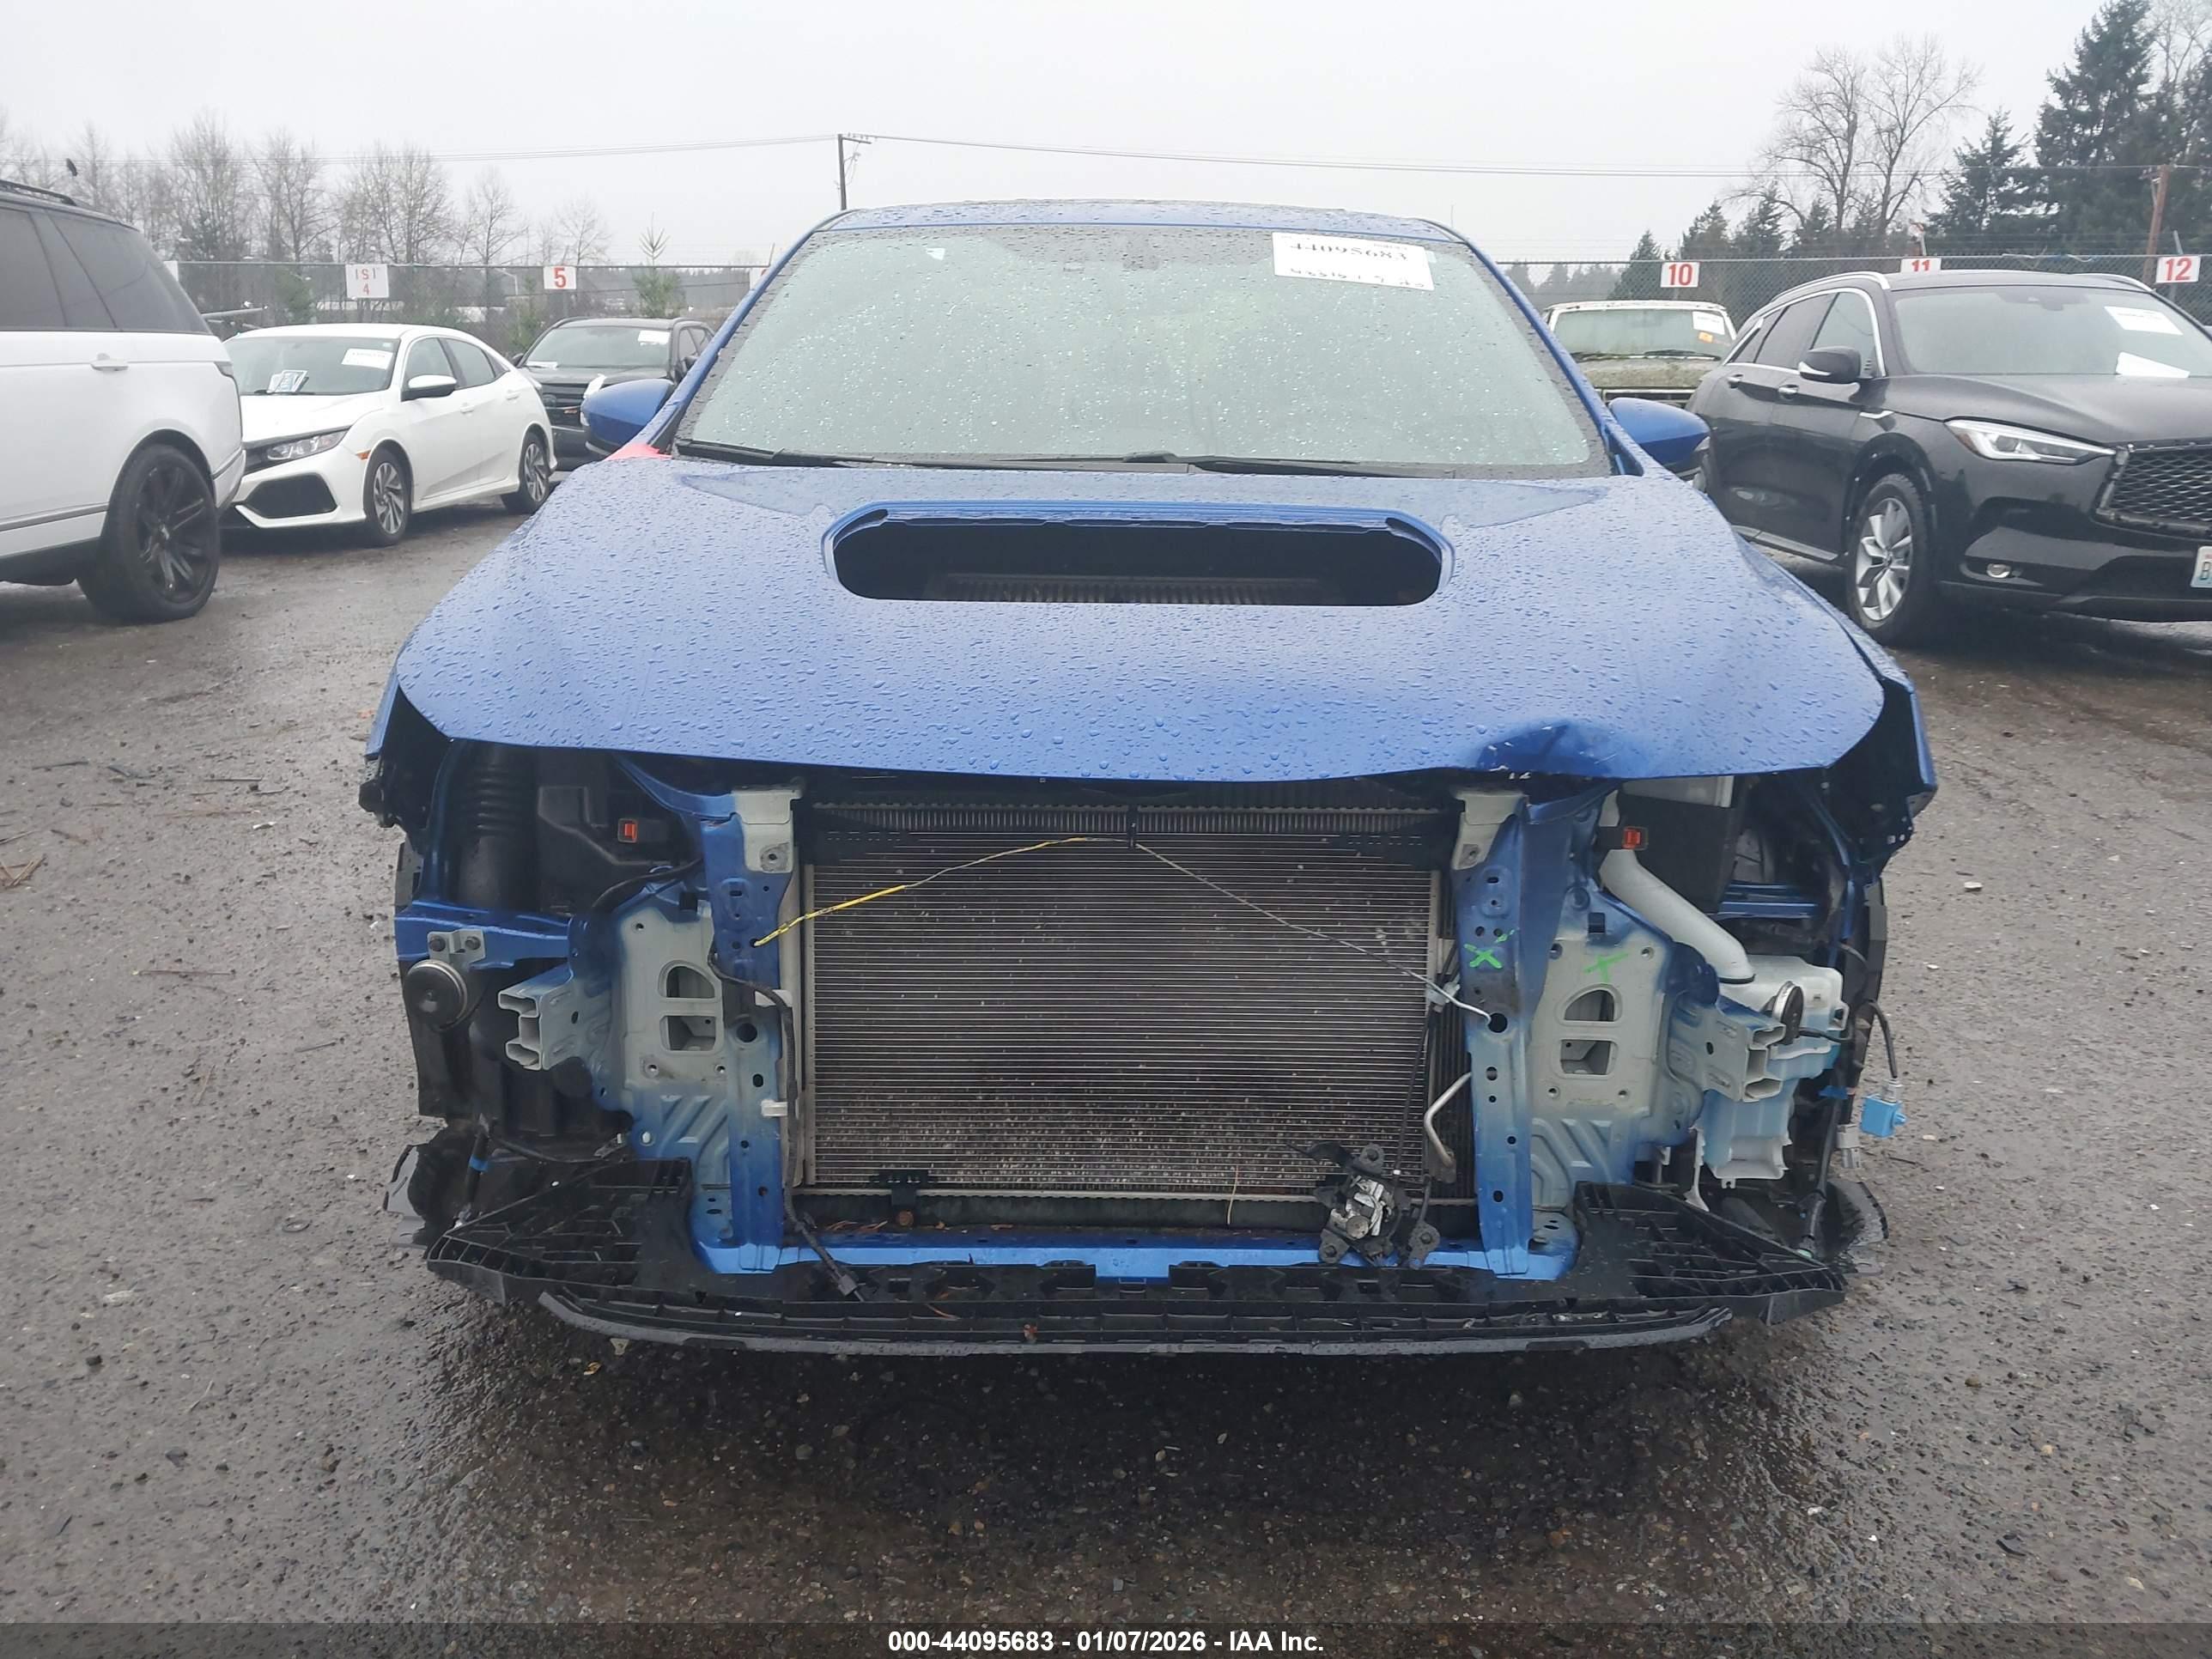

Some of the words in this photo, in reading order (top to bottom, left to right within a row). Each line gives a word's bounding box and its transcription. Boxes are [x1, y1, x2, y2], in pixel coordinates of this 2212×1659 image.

[1668, 264, 1693, 286] 10
[1911, 259, 1930, 272] 11
[2166, 257, 2192, 282] 12
[362, 283, 370, 295] 4
[554, 267, 567, 289] 5
